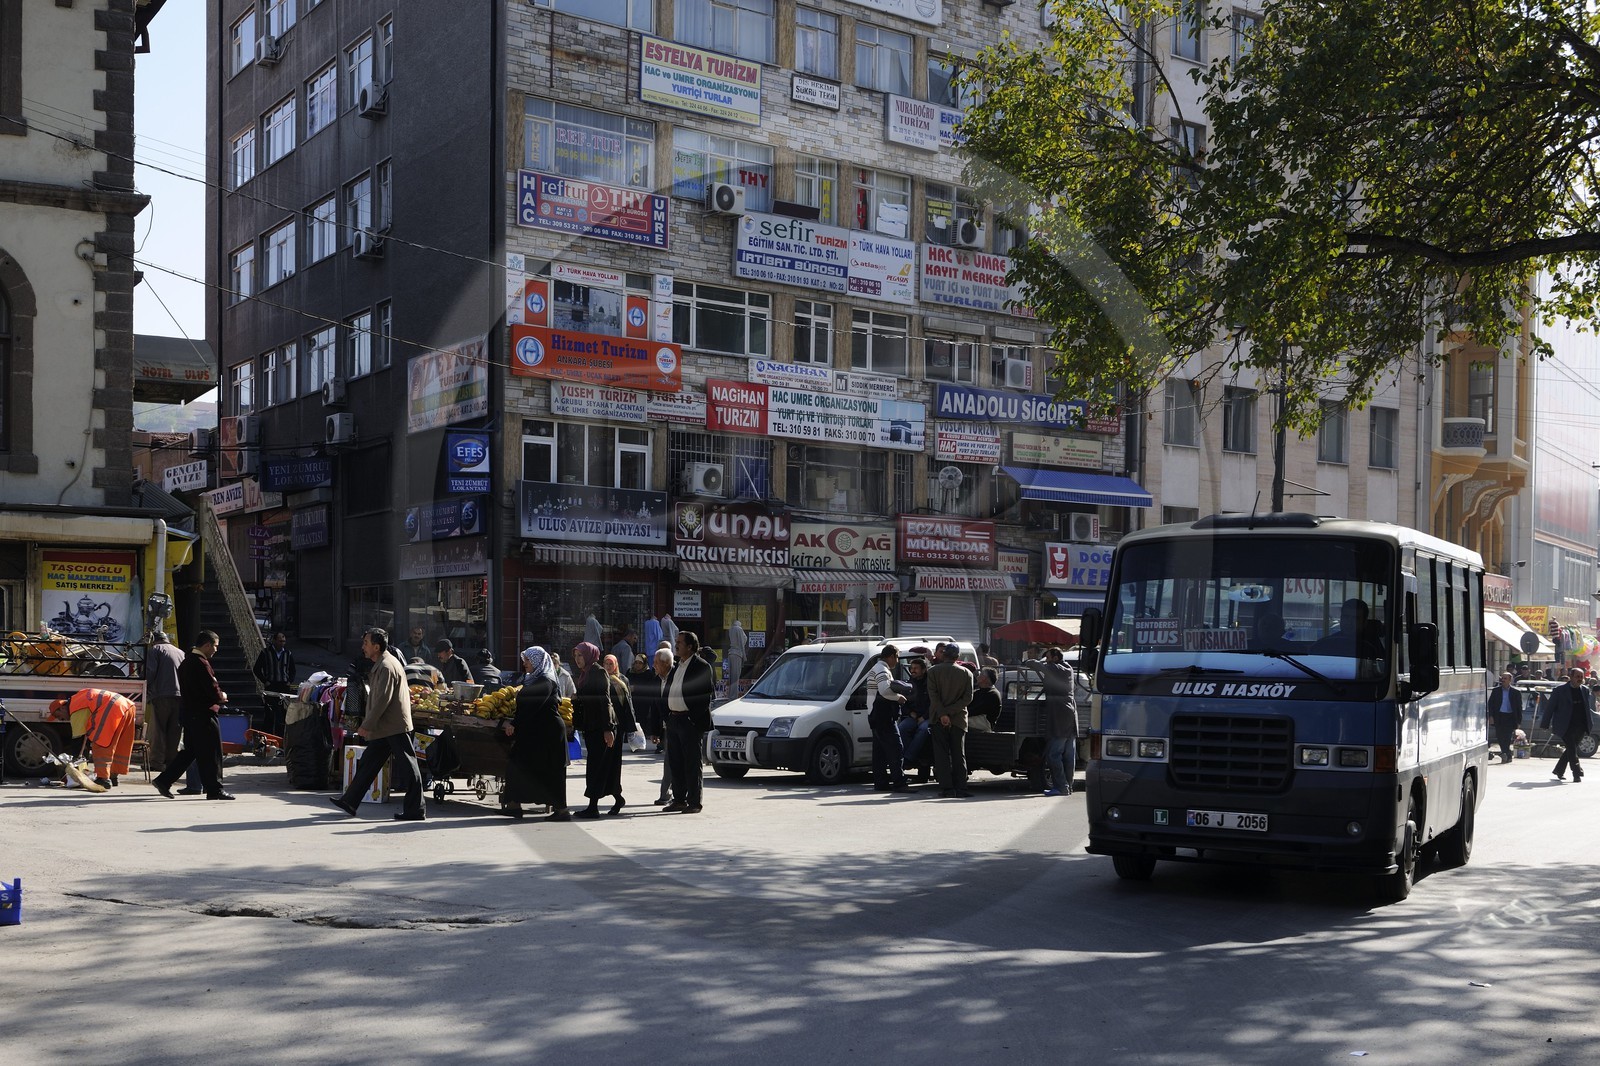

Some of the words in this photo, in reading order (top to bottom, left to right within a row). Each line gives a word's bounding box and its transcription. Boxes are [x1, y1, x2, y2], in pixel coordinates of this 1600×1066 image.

[645, 42, 703, 71] ESTELYA
[706, 56, 758, 84] TURİZM
[645, 66, 661, 76] HAC
[673, 74, 695, 85] UMRE
[696, 78, 759, 100] ORGANİZASYONU
[672, 84, 702, 99] YURTİÇİ
[703, 91, 733, 105] TURLAR
[630, 122, 649, 133] THY
[899, 115, 930, 131] TURİZM
[532, 121, 540, 162] UMRE
[592, 134, 622, 155] TUR
[740, 169, 768, 188] THY
[523, 174, 536, 223] HAC
[541, 180, 589, 202] reftur
[610, 190, 649, 210] THY
[822, 179, 830, 219] HAC
[539, 218, 551, 226] TEL:
[552, 220, 562, 229] 309
[611, 230, 624, 238] FAX:
[643, 235, 650, 243] 75
[653, 198, 666, 245] UMRE
[760, 219, 814, 243] sefir
[748, 235, 774, 250] EĞİTİM
[776, 242, 793, 254] SAN.
[794, 242, 807, 256] TİC.
[809, 246, 824, 258] LTD.
[826, 248, 839, 262] ŞTİ.
[815, 235, 847, 250] TURİZM
[859, 239, 873, 253] TÜRK
[875, 243, 890, 256] HAVA
[892, 246, 913, 259] YOLLARI
[742, 250, 791, 269] İRTİBAT
[794, 259, 843, 278] BÜROSU
[860, 261, 887, 272] atlasjet
[928, 246, 953, 264] HAC
[956, 252, 970, 267] ve
[974, 254, 1006, 273] UMRE
[583, 270, 596, 278] HAVA
[740, 267, 750, 276] TEL:
[751, 268, 759, 278] 310
[760, 270, 766, 279] 06
[768, 271, 773, 280] 10
[777, 272, 787, 282] FAX:
[788, 274, 796, 284] 310
[811, 278, 820, 287] KAT
[829, 281, 838, 290] NO:
[839, 282, 845, 291] 22
[886, 275, 909, 284] PEGASUS
[925, 264, 959, 279] KAYIT
[960, 285, 970, 295] ve
[933, 292, 999, 310] TURLARI
[551, 333, 599, 356] Hizmet
[601, 341, 648, 361] Turizm
[556, 354, 587, 368] ANKARA
[766, 362, 828, 378] NAGİHAN
[142, 366, 173, 379] HOTEL
[185, 369, 210, 381] ULUS
[560, 384, 594, 401] YUSEM
[711, 385, 765, 406] NAGİHAN
[554, 396, 560, 404] A
[561, 397, 583, 407] GRUBU
[587, 400, 613, 410] SEYAHAT
[616, 404, 645, 413] ACENTASI
[771, 390, 789, 404] HAC
[790, 391, 813, 407] UMRE
[814, 395, 878, 414] ORGANİZASYONU
[941, 391, 1017, 420] ANADOLU
[556, 404, 569, 413] HAC
[572, 406, 589, 415] UMRE
[592, 407, 643, 420] ORGANİZASYONU
[714, 405, 759, 428] TURİZM
[772, 422, 788, 434] TEL:
[789, 423, 802, 435] 310
[803, 425, 812, 436] 59
[812, 427, 821, 437] 81
[824, 427, 844, 440] FAKS:
[845, 430, 857, 441] 310
[858, 431, 867, 442] 00
[868, 433, 876, 443] 70
[456, 446, 483, 458] EFES
[939, 440, 956, 452] HAC
[212, 491, 226, 506] REN
[538, 516, 567, 533] ULUS
[569, 515, 602, 535] AVİZE
[604, 518, 651, 538] DÜNYASI
[709, 504, 789, 542] ÜNAL
[906, 520, 962, 538] ECZANE
[906, 537, 989, 554] MÜHÜRDAR
[676, 544, 789, 567] KURUYEMİŞÇİSİ
[791, 553, 831, 569] KİTAP
[853, 557, 891, 571] KIRTASİYE
[906, 551, 924, 560] TEL:
[926, 552, 948, 561] 0312
[949, 553, 965, 561] 309
[967, 554, 978, 562] 45
[979, 554, 990, 563] 46
[1003, 564, 1023, 573] HAN
[48, 572, 66, 581] HAC
[67, 574, 127, 584] MALZEMELERİ
[56, 581, 76, 591] SATIŞ
[80, 582, 114, 591] MERKEZİ
[919, 574, 966, 590] MÜHÜRDAR
[967, 576, 1007, 590] ECZANESİ
[902, 603, 923, 615] ECZANE
[1137, 630, 1177, 645] ULUS
[1184, 629, 1247, 651] PURSAKLAR
[1171, 682, 1216, 696] ULUS
[1220, 682, 1297, 698] HASKÖY
[716, 740, 722, 748] 06
[1155, 811, 1167, 824] L
[1195, 812, 1210, 826] 06
[1217, 813, 1225, 827] J
[1237, 815, 1267, 830] 2056
